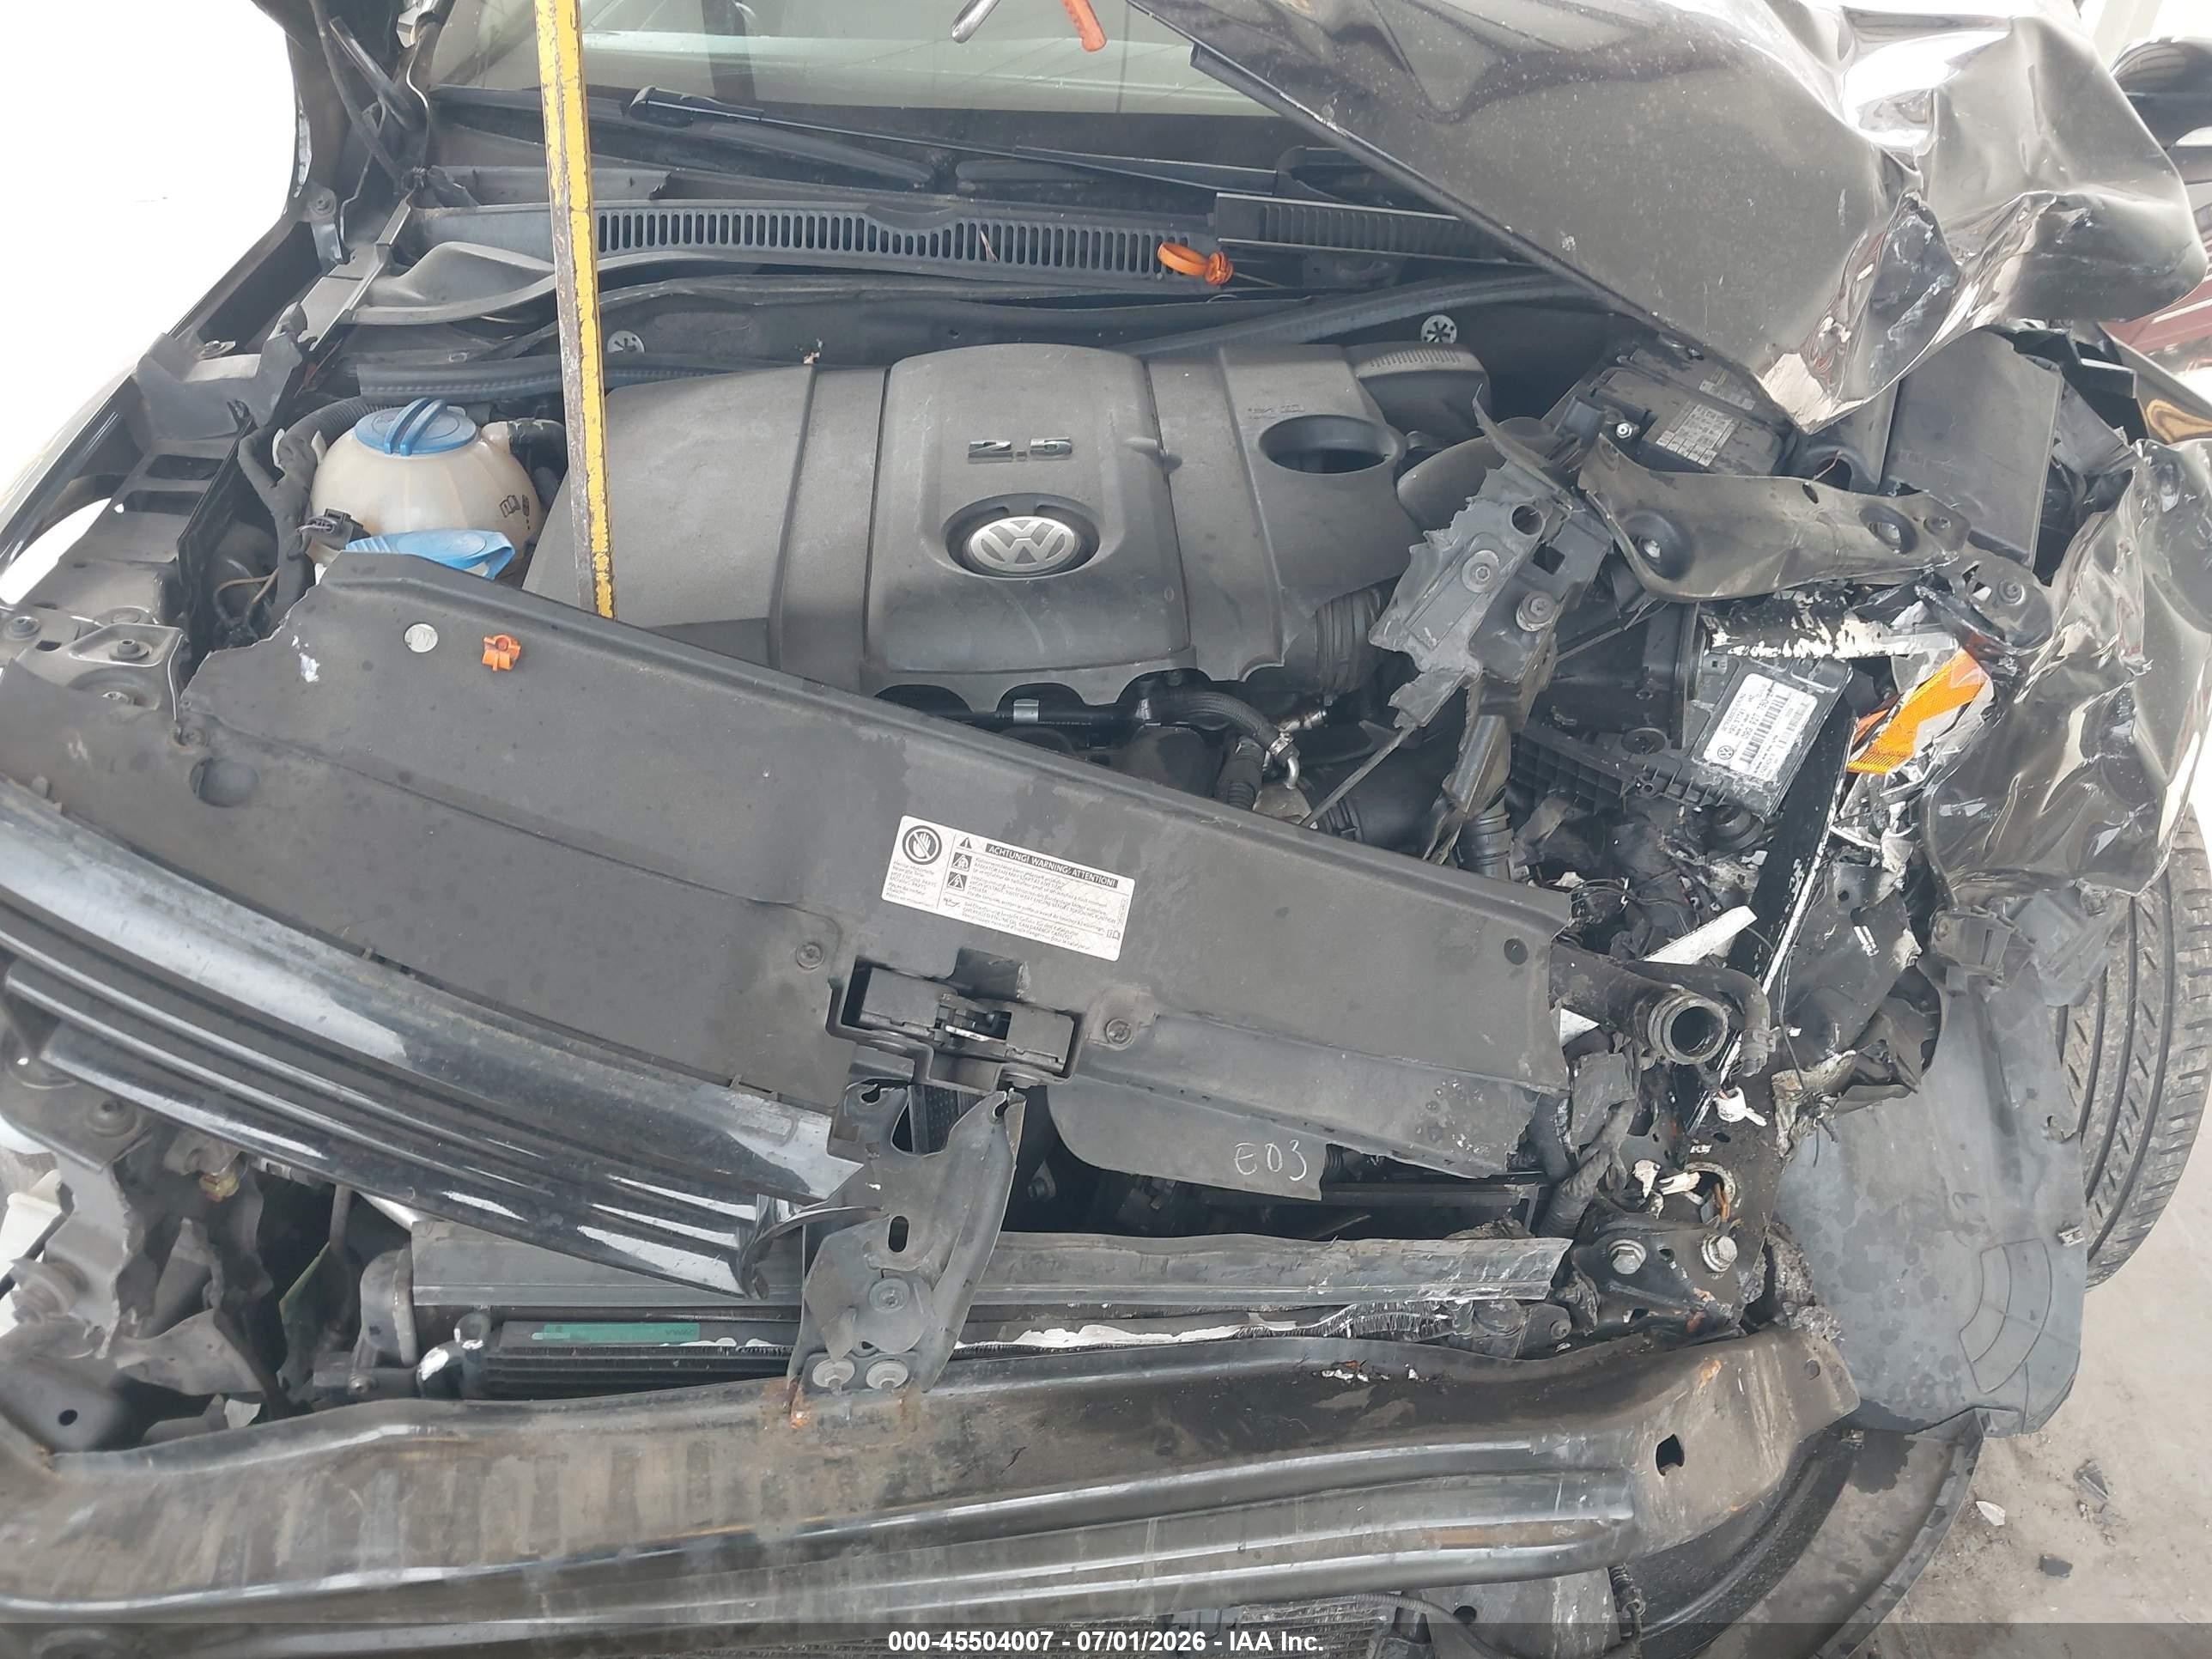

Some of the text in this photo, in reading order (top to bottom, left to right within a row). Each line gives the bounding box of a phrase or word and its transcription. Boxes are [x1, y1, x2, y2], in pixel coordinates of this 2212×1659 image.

[968, 438, 1072, 464] 2.5
[988, 844, 1030, 863] ACHTUNG!
[1072, 867, 1115, 887] ATTENTION!
